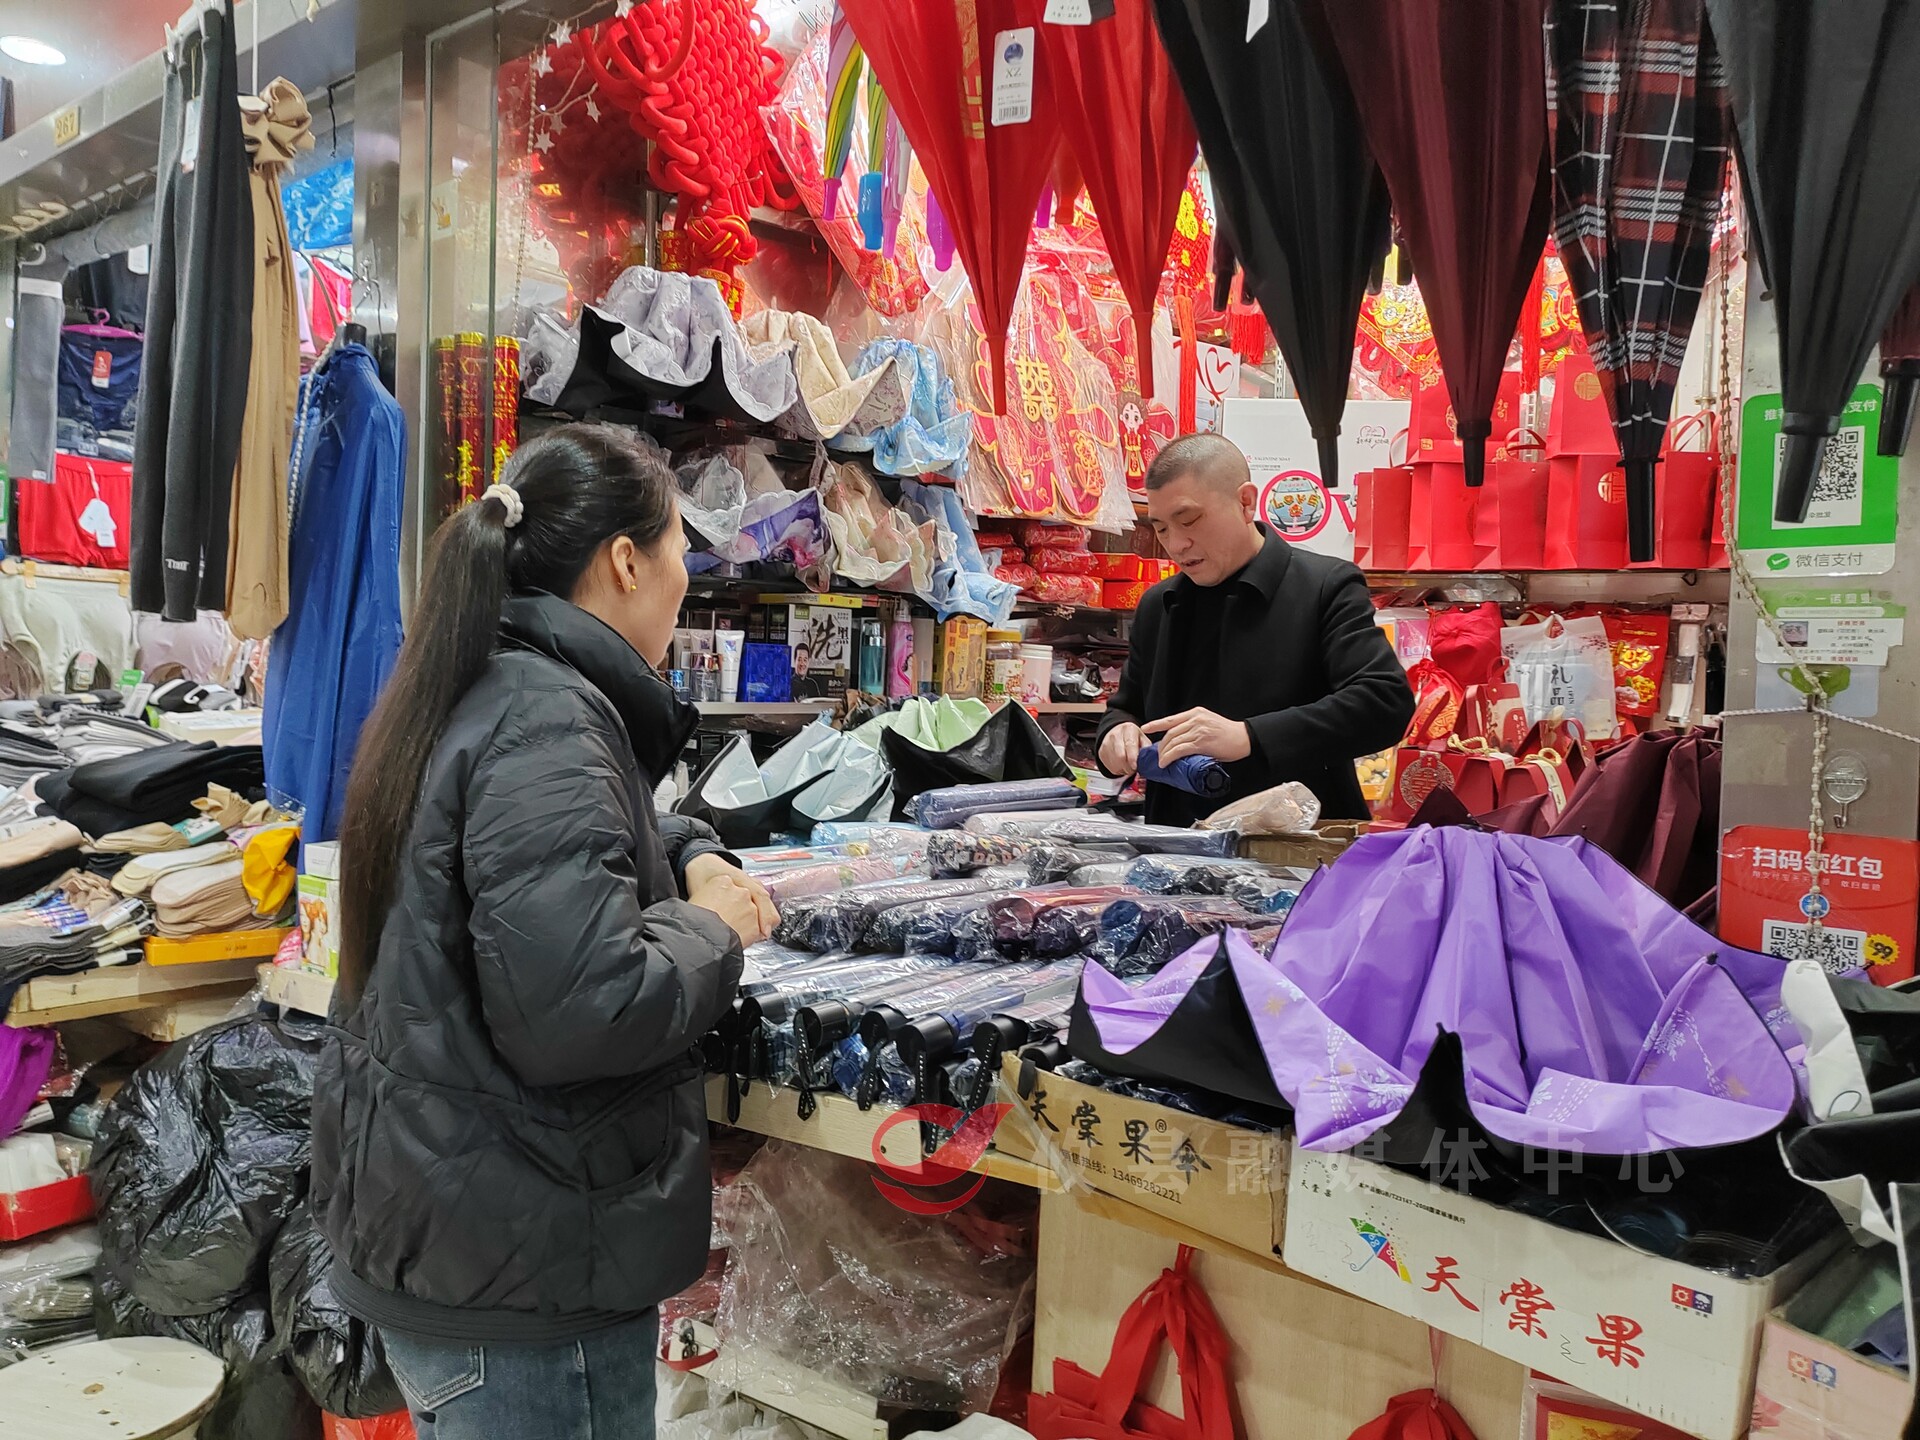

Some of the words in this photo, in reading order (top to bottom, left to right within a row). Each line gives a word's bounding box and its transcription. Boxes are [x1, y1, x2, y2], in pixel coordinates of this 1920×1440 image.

[1271, 493, 1321, 510] LOVE
[1796, 552, 1863, 568] 微信支付
[1550, 664, 1573, 706] 礼品
[1752, 848, 1884, 880] 扫码领红包
[1421, 1256, 1646, 1369] 天棠果
